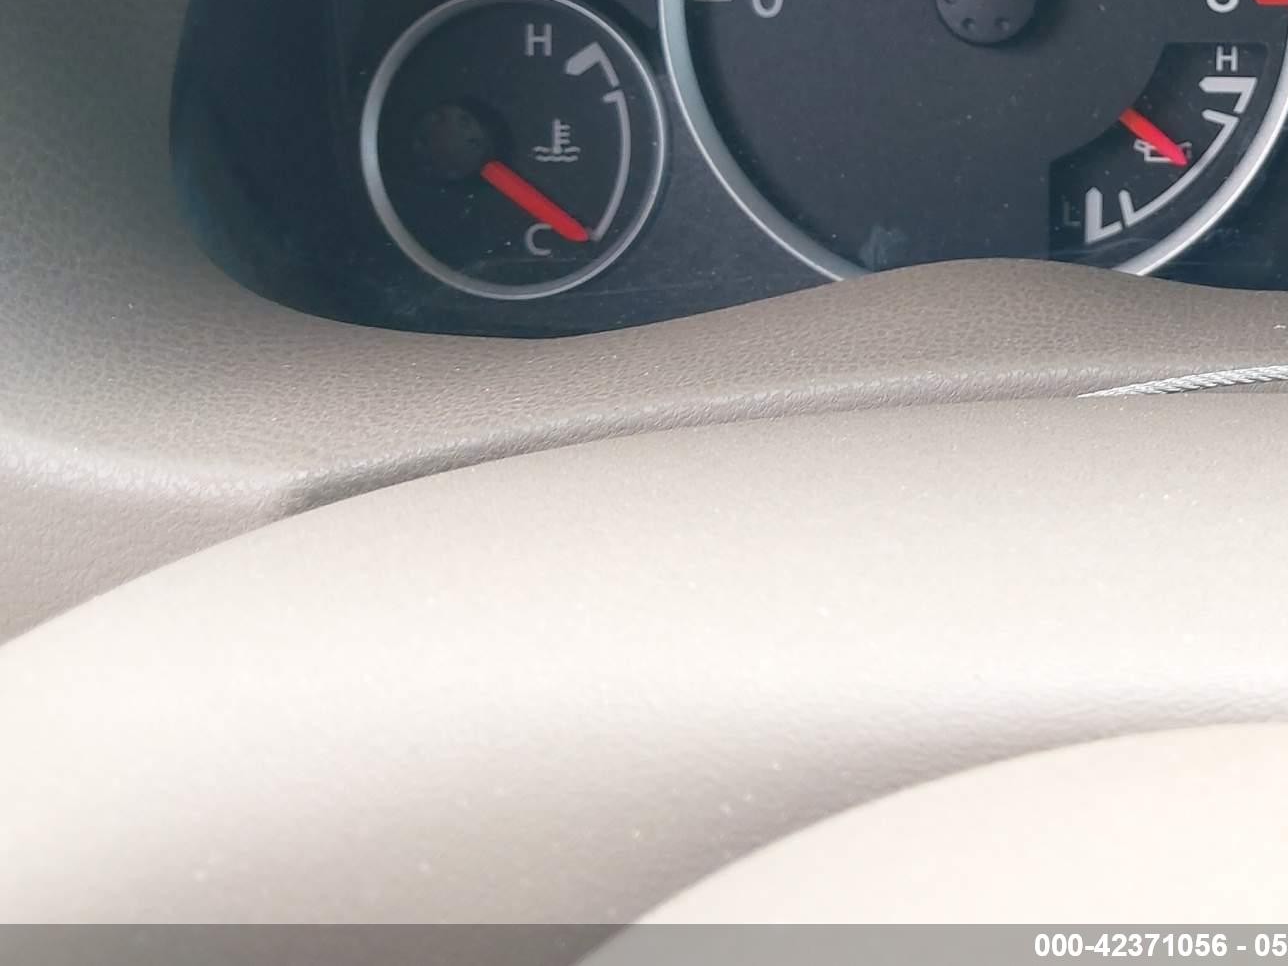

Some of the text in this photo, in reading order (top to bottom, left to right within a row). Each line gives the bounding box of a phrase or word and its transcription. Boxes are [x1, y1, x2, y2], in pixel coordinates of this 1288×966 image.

[525, 24, 553, 57] H
[1215, 46, 1239, 72] H
[525, 222, 554, 256] C
